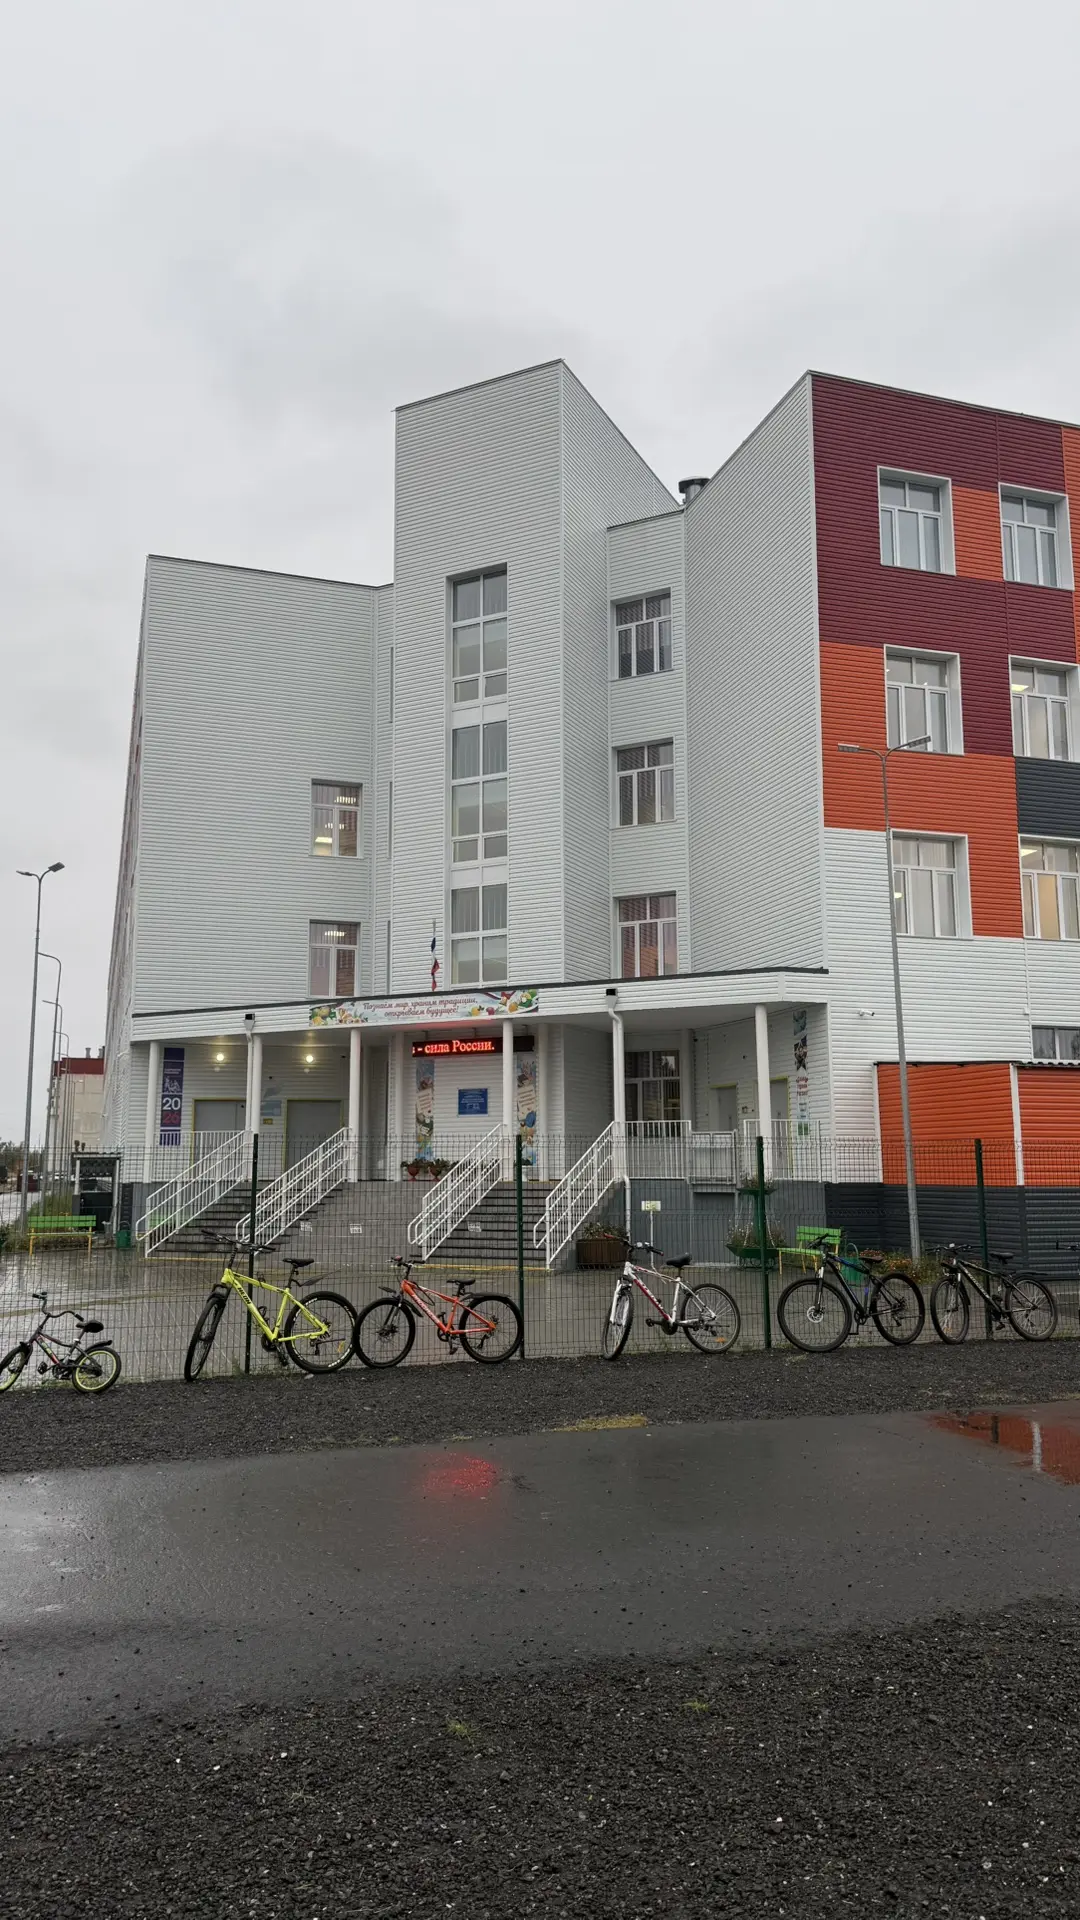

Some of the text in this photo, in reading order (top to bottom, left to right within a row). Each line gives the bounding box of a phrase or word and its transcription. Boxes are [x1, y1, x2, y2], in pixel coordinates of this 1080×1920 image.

[426, 1006, 459, 1017] будущее!
[424, 1045, 449, 1053] сила
[452, 1040, 495, 1052] России.
[162, 1097, 181, 1110] 20
